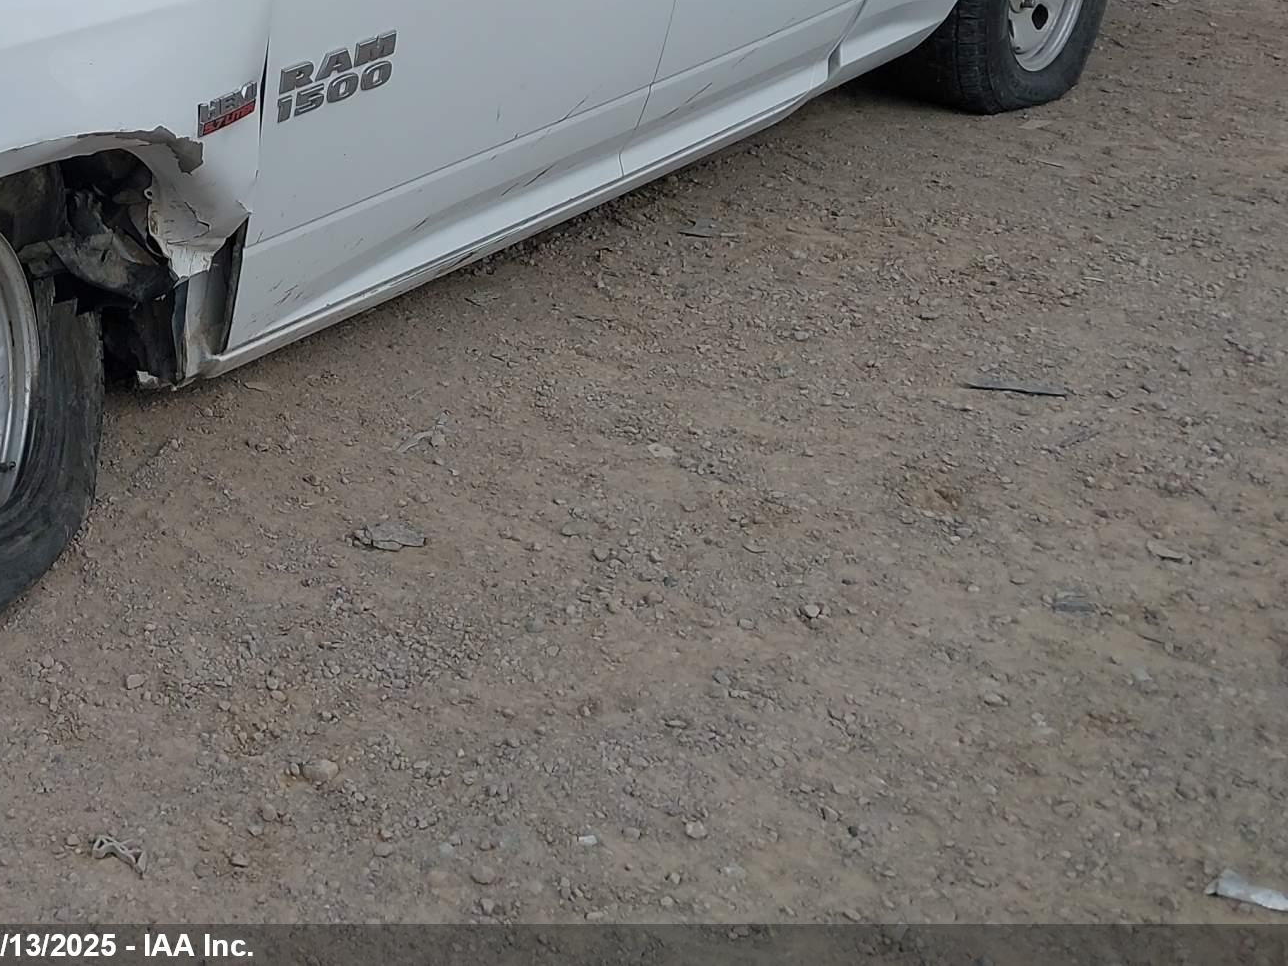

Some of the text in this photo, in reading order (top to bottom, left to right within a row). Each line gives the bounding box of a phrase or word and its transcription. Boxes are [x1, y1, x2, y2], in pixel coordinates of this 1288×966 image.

[277, 60, 393, 124] 1500
[278, 29, 397, 95] RAM
[198, 81, 257, 123] HEMI
